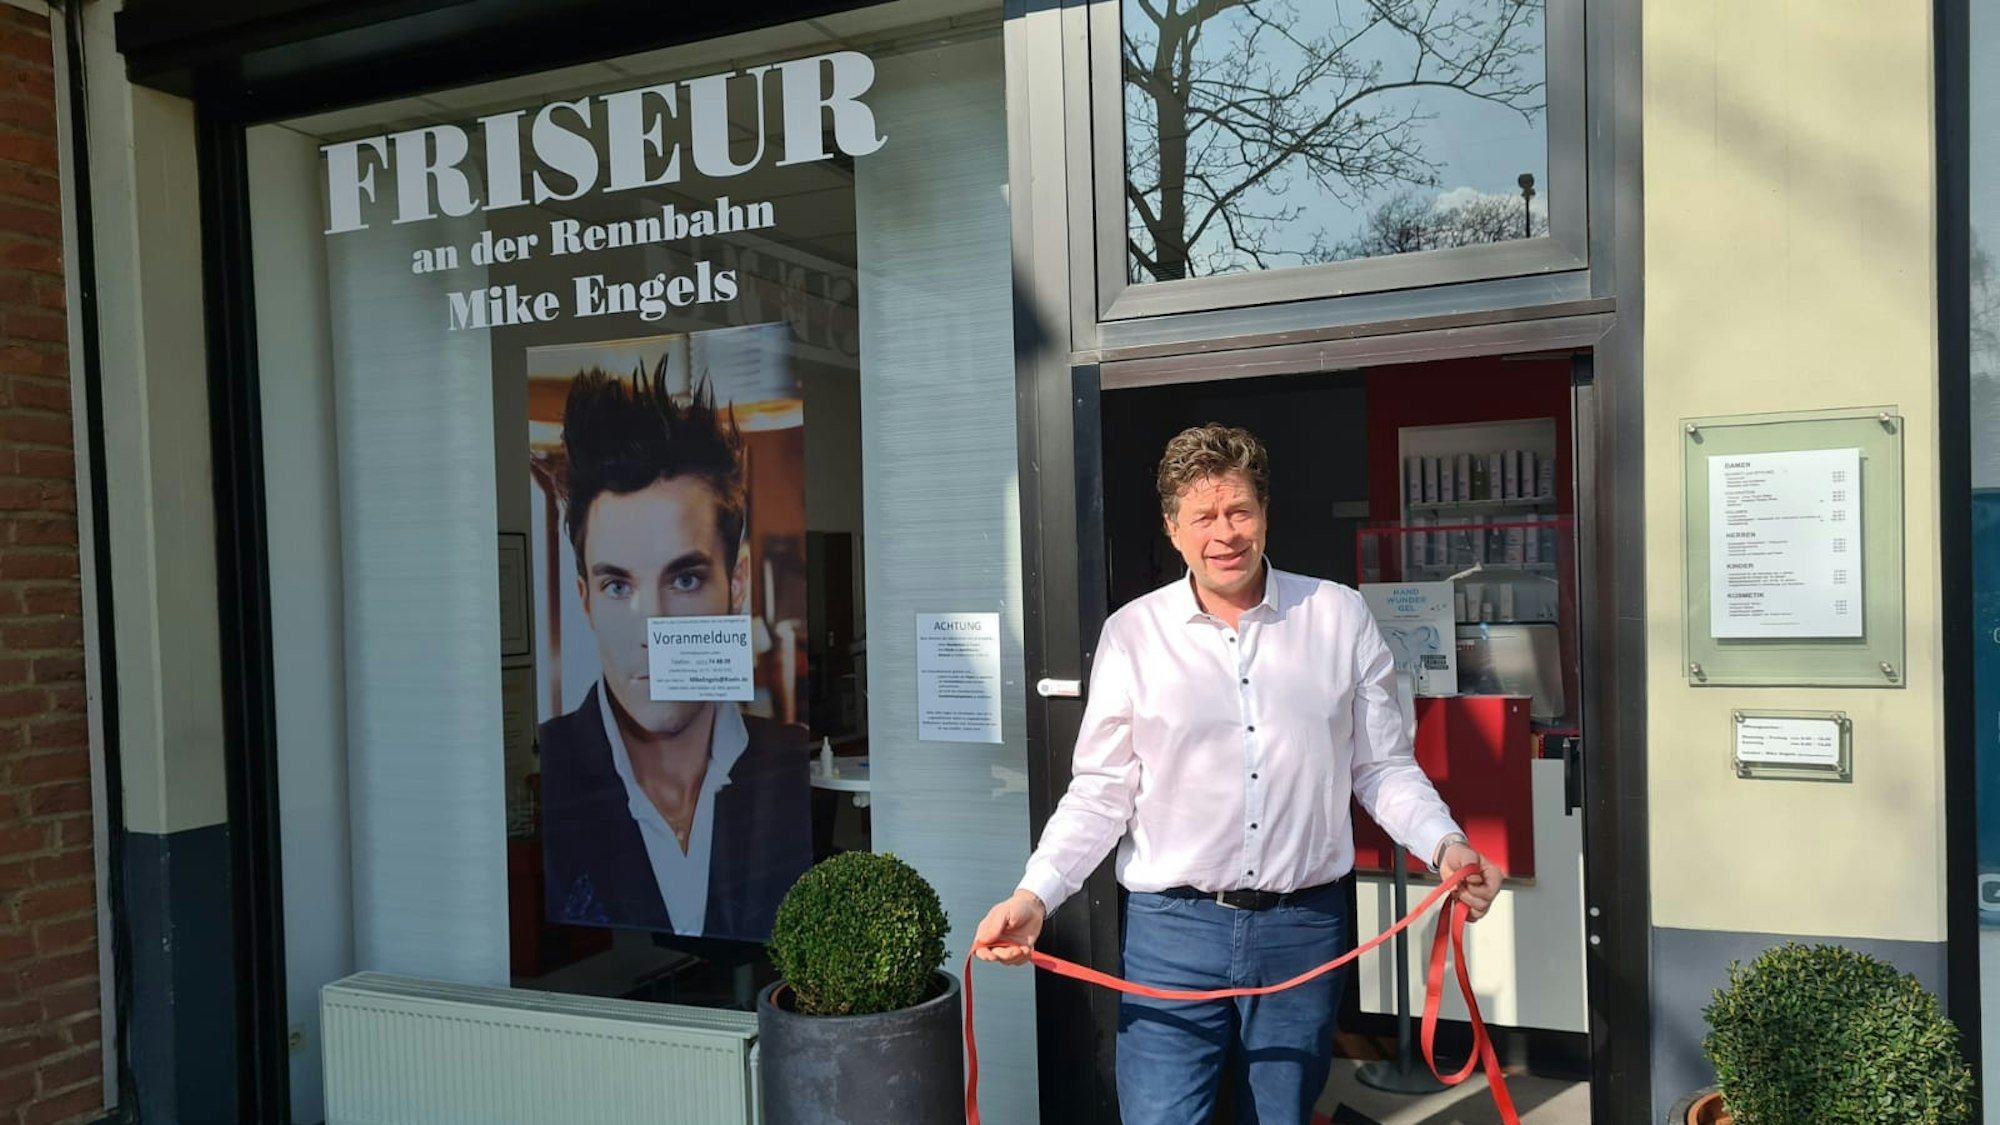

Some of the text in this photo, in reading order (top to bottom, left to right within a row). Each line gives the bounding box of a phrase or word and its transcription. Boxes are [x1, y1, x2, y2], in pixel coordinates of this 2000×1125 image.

[320, 51, 888, 234] FRISEUR
[412, 196, 777, 274] an der Rennbahn
[447, 284, 560, 332] Mike
[572, 261, 739, 322] Engels
[1393, 588, 1420, 596] HAND
[1386, 596, 1427, 604] WUNDER
[1398, 604, 1417, 612] GEL
[934, 621, 982, 631] ACHTUNG
[653, 630, 748, 647] Voranmeldung
